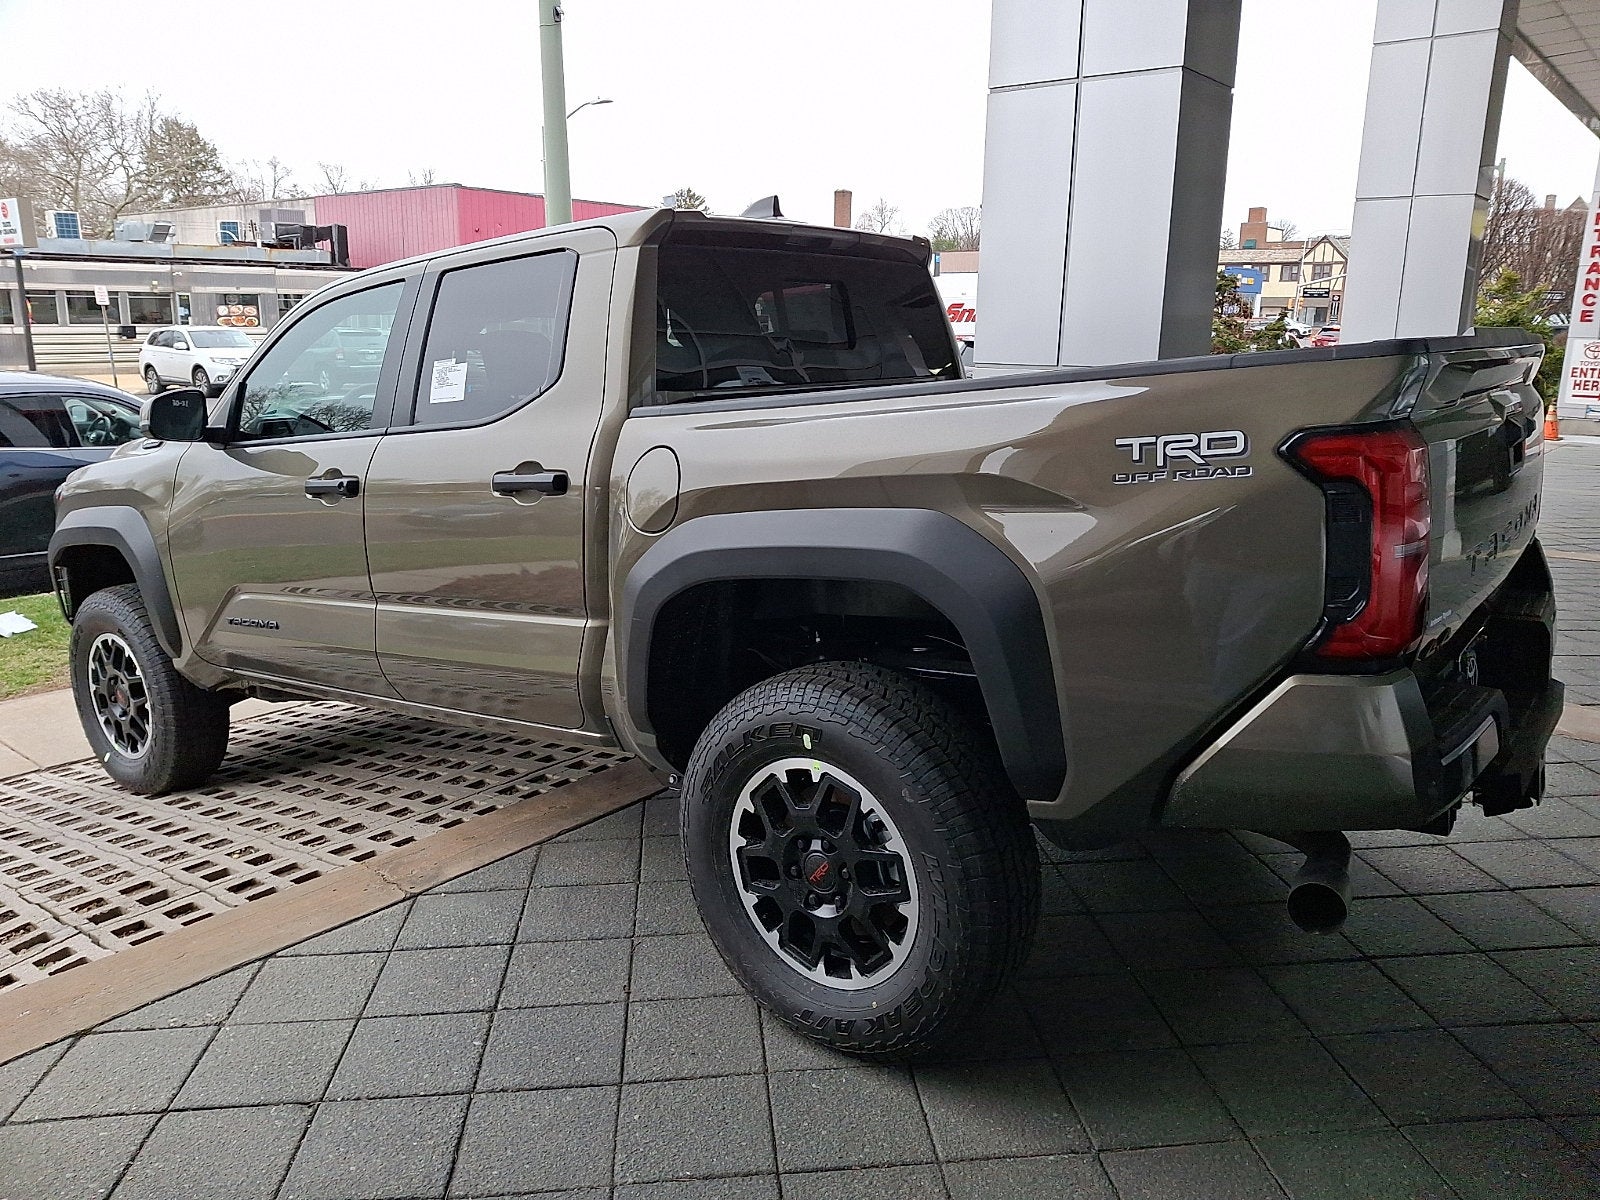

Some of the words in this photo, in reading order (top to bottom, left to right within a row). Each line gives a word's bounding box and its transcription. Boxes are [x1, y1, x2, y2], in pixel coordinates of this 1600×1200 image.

[946, 303, 977, 323] Sn
[1115, 430, 1249, 469] TRD
[1112, 470, 1168, 485] OFF
[1172, 465, 1253, 483] ROAD
[226, 616, 280, 630] TACOMA
[809, 860, 829, 882] TRD
